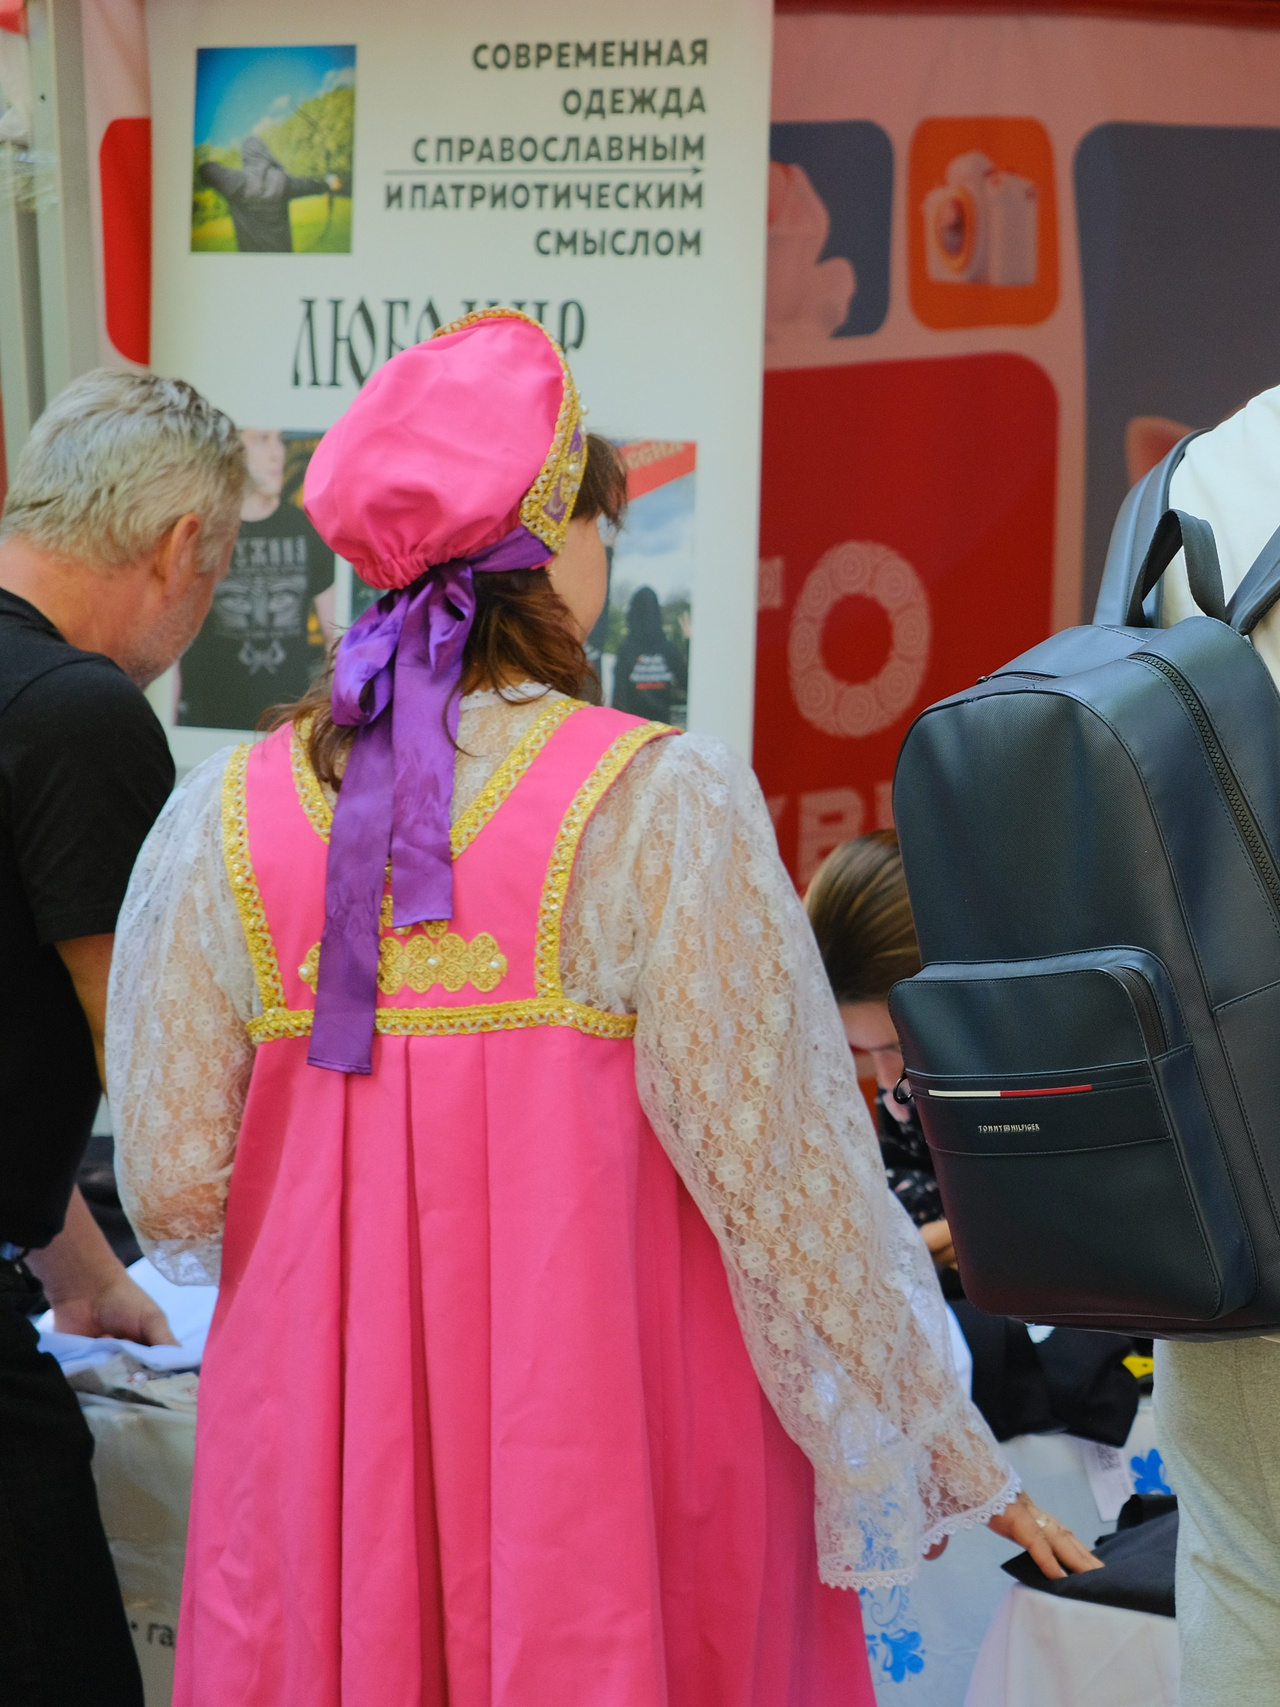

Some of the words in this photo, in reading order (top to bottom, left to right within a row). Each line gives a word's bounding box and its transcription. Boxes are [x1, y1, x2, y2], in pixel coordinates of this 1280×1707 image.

[472, 38, 708, 70] СОВРЕМЕННАЯ
[562, 86, 706, 119] ОДЕЖДА
[413, 138, 428, 163] С
[435, 134, 705, 162] ПРАВОСЛАВНЫМ
[385, 184, 402, 209] И
[410, 183, 703, 209] ПАТРИОТИЧЕСКИМ
[535, 230, 702, 256] СМЫСЛОМ
[978, 1125, 1003, 1134] TOMMY
[1010, 1123, 1040, 1133] HILFIGER
